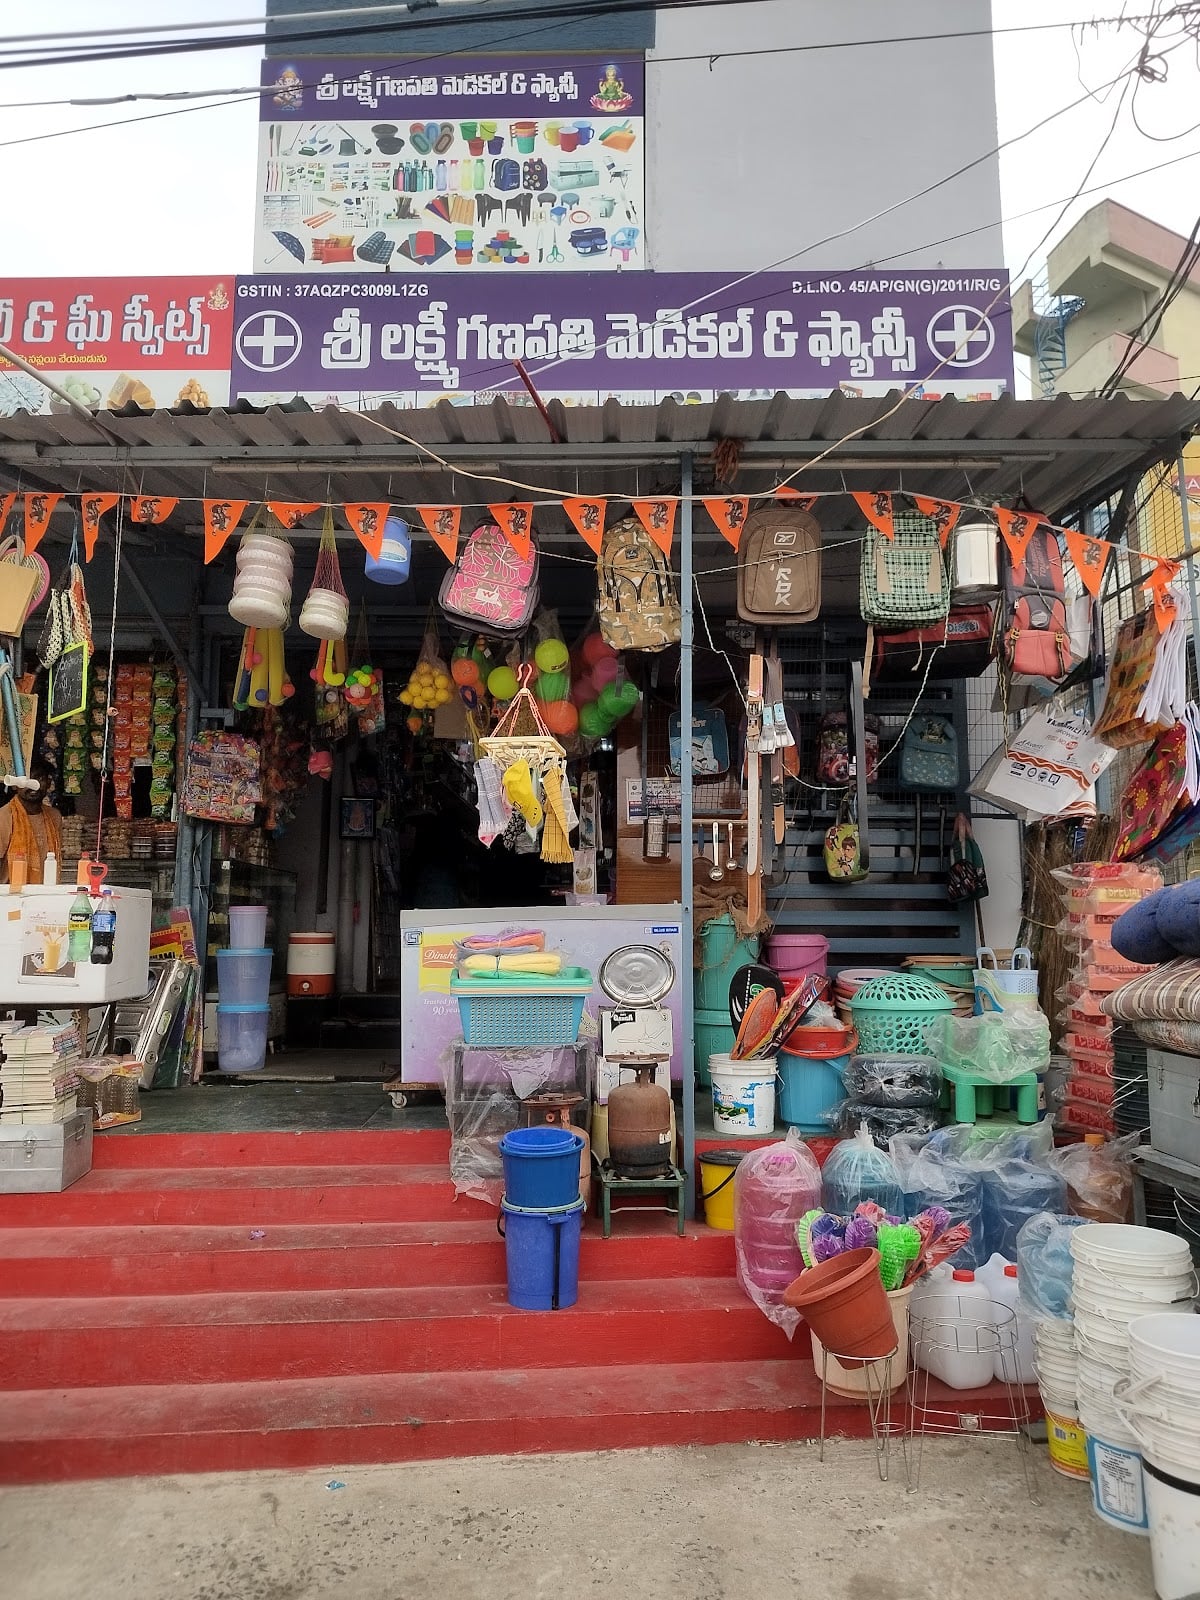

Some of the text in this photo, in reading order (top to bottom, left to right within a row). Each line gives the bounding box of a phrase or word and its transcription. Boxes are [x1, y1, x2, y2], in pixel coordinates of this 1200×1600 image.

[316, 73, 339, 101] శ్రీ
[376, 75, 438, 96] గణపతి
[511, 73, 527, 94] &
[237, 285, 282, 297] GSTIN
[294, 284, 429, 297] 37AQZPC3009L1ZG
[792, 279, 1001, 294] D.L.NO. 45/AP/GN(G)/2011/R/G
[24, 301, 57, 342] &
[321, 308, 372, 369] శ్రీ
[381, 301, 459, 389] లక్ష్మీ
[457, 314, 596, 360] గణపతి
[763, 310, 799, 358] &
[807, 307, 917, 378] ఫ్యాన్సీ
